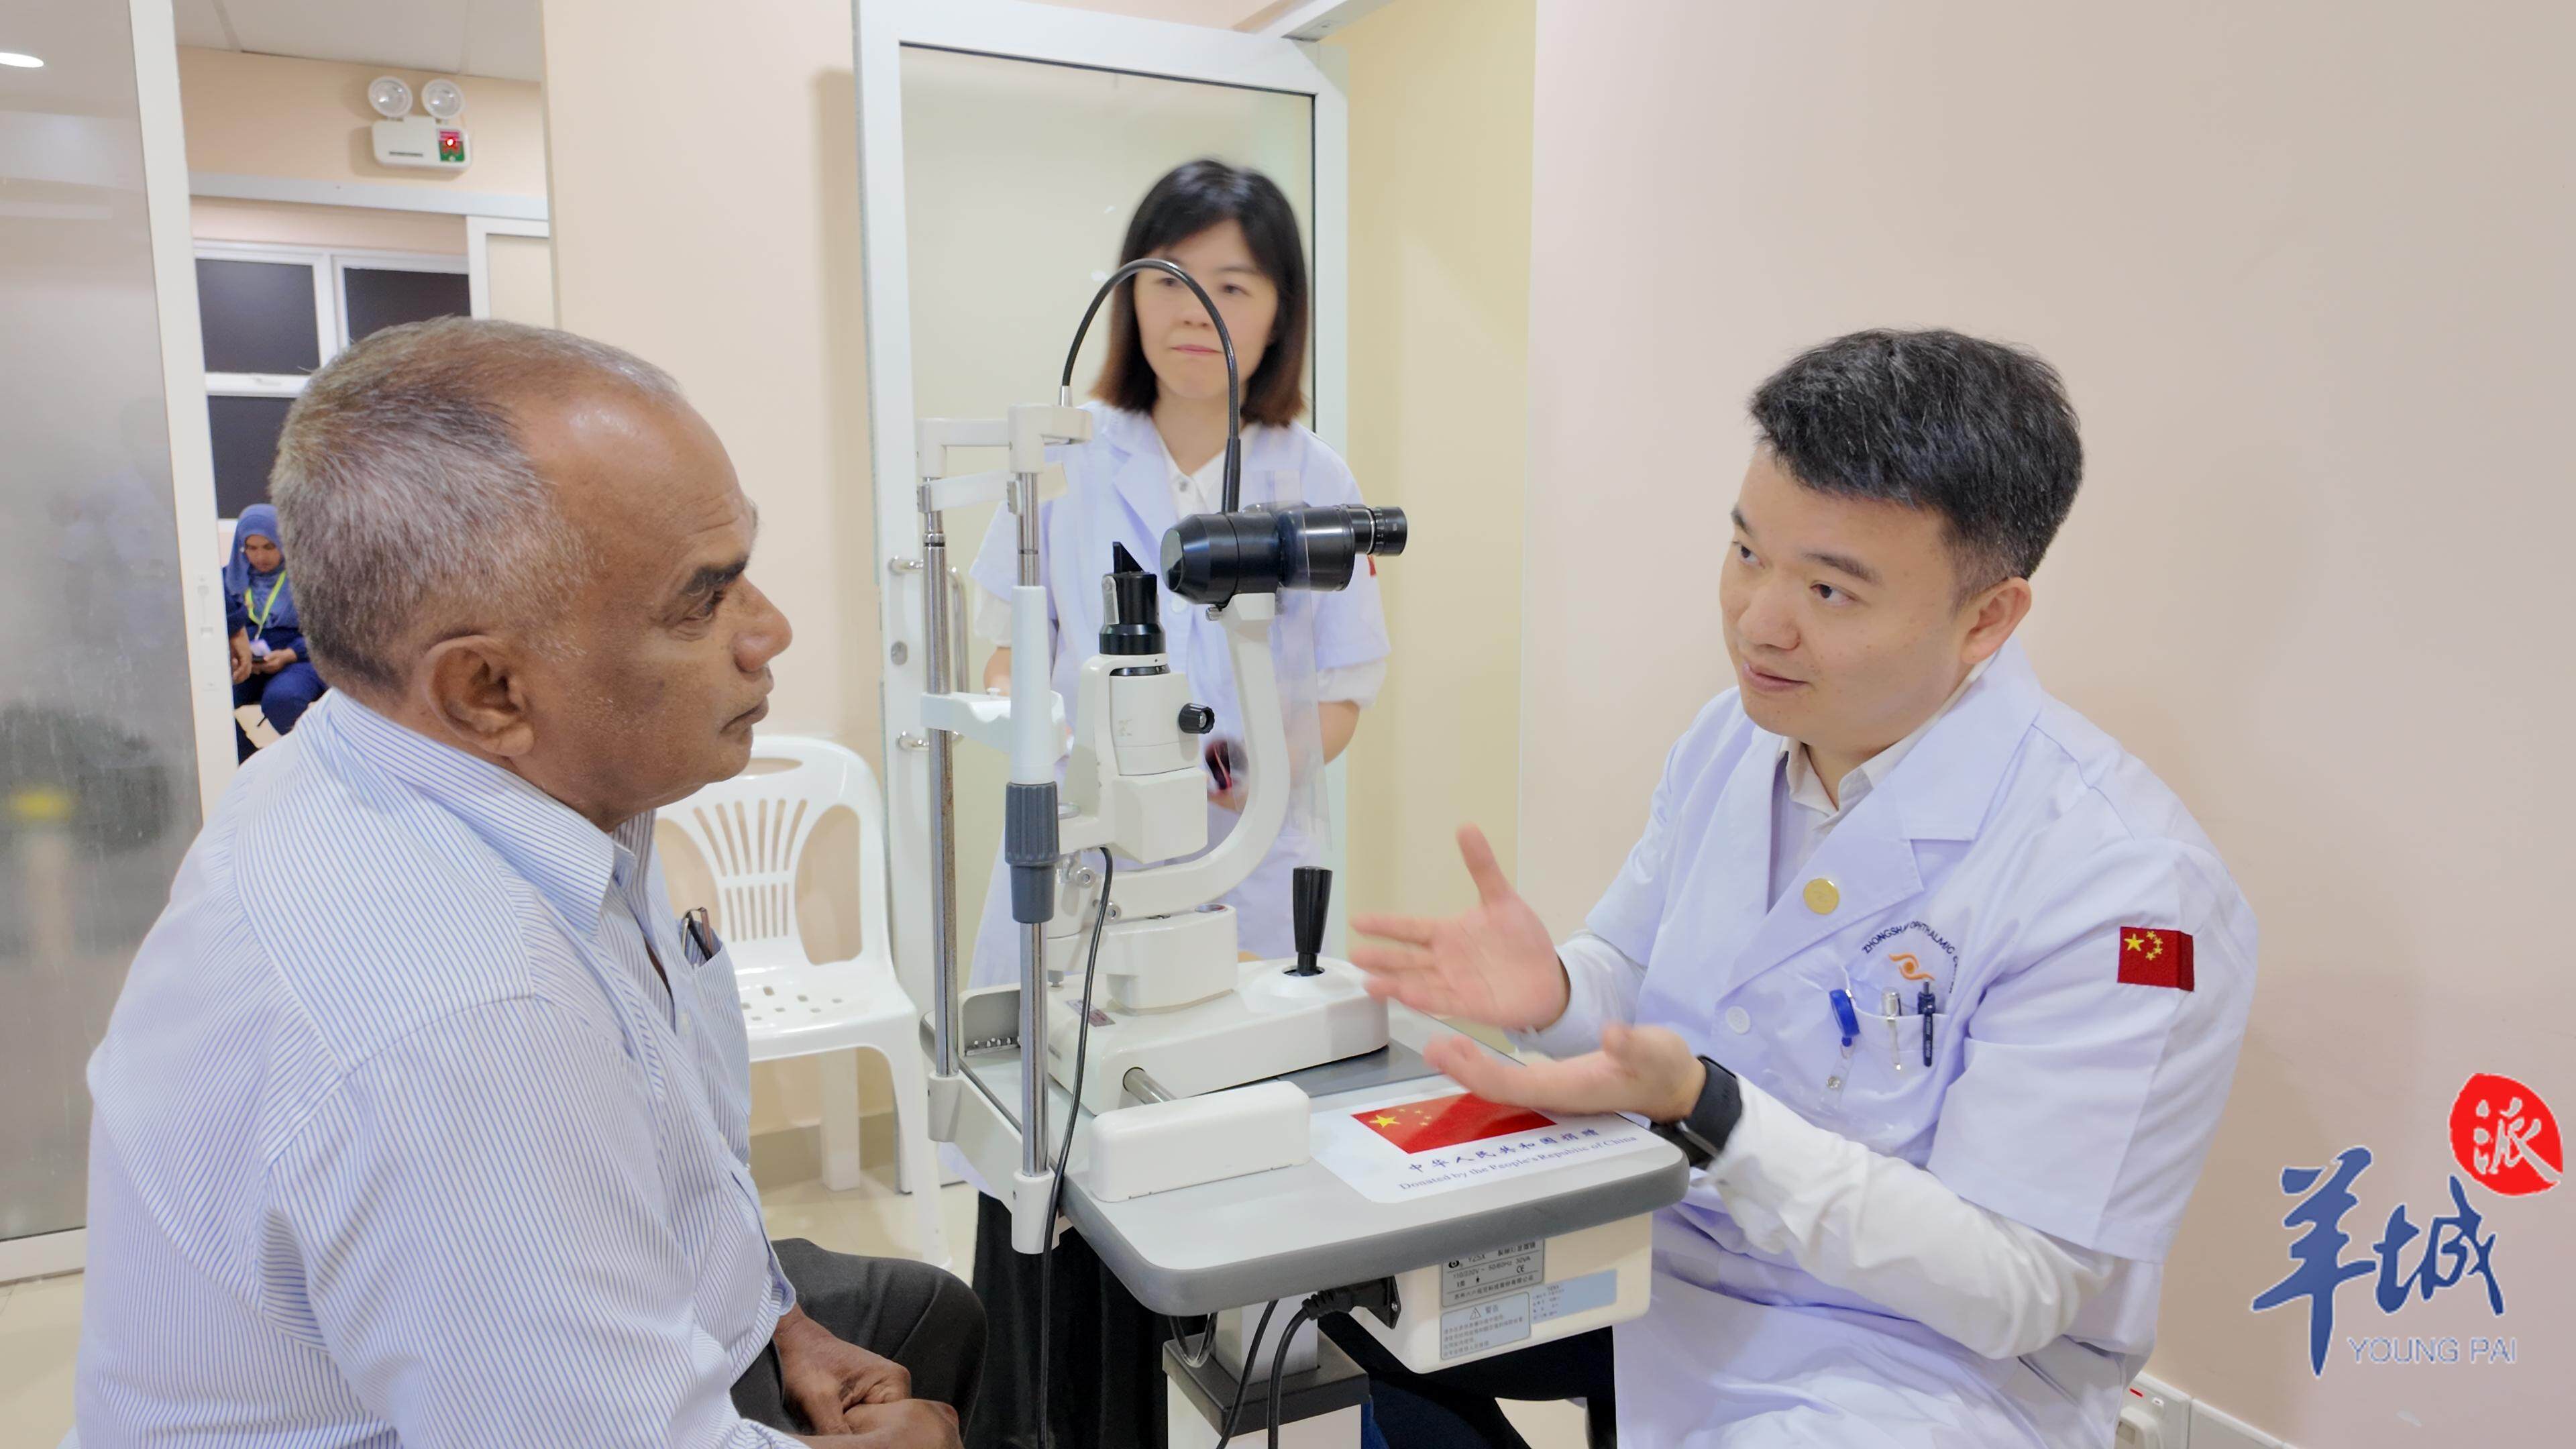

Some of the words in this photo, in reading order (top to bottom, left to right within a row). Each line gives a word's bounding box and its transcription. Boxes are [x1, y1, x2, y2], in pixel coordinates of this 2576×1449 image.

[1862, 922, 1910, 954] ZHONGSH
[1399, 1175, 1451, 1189] Donated
[1489, 1157, 1538, 1170] People's
[1538, 1146, 1589, 1160] Republic
[1603, 1135, 1638, 1146] China
